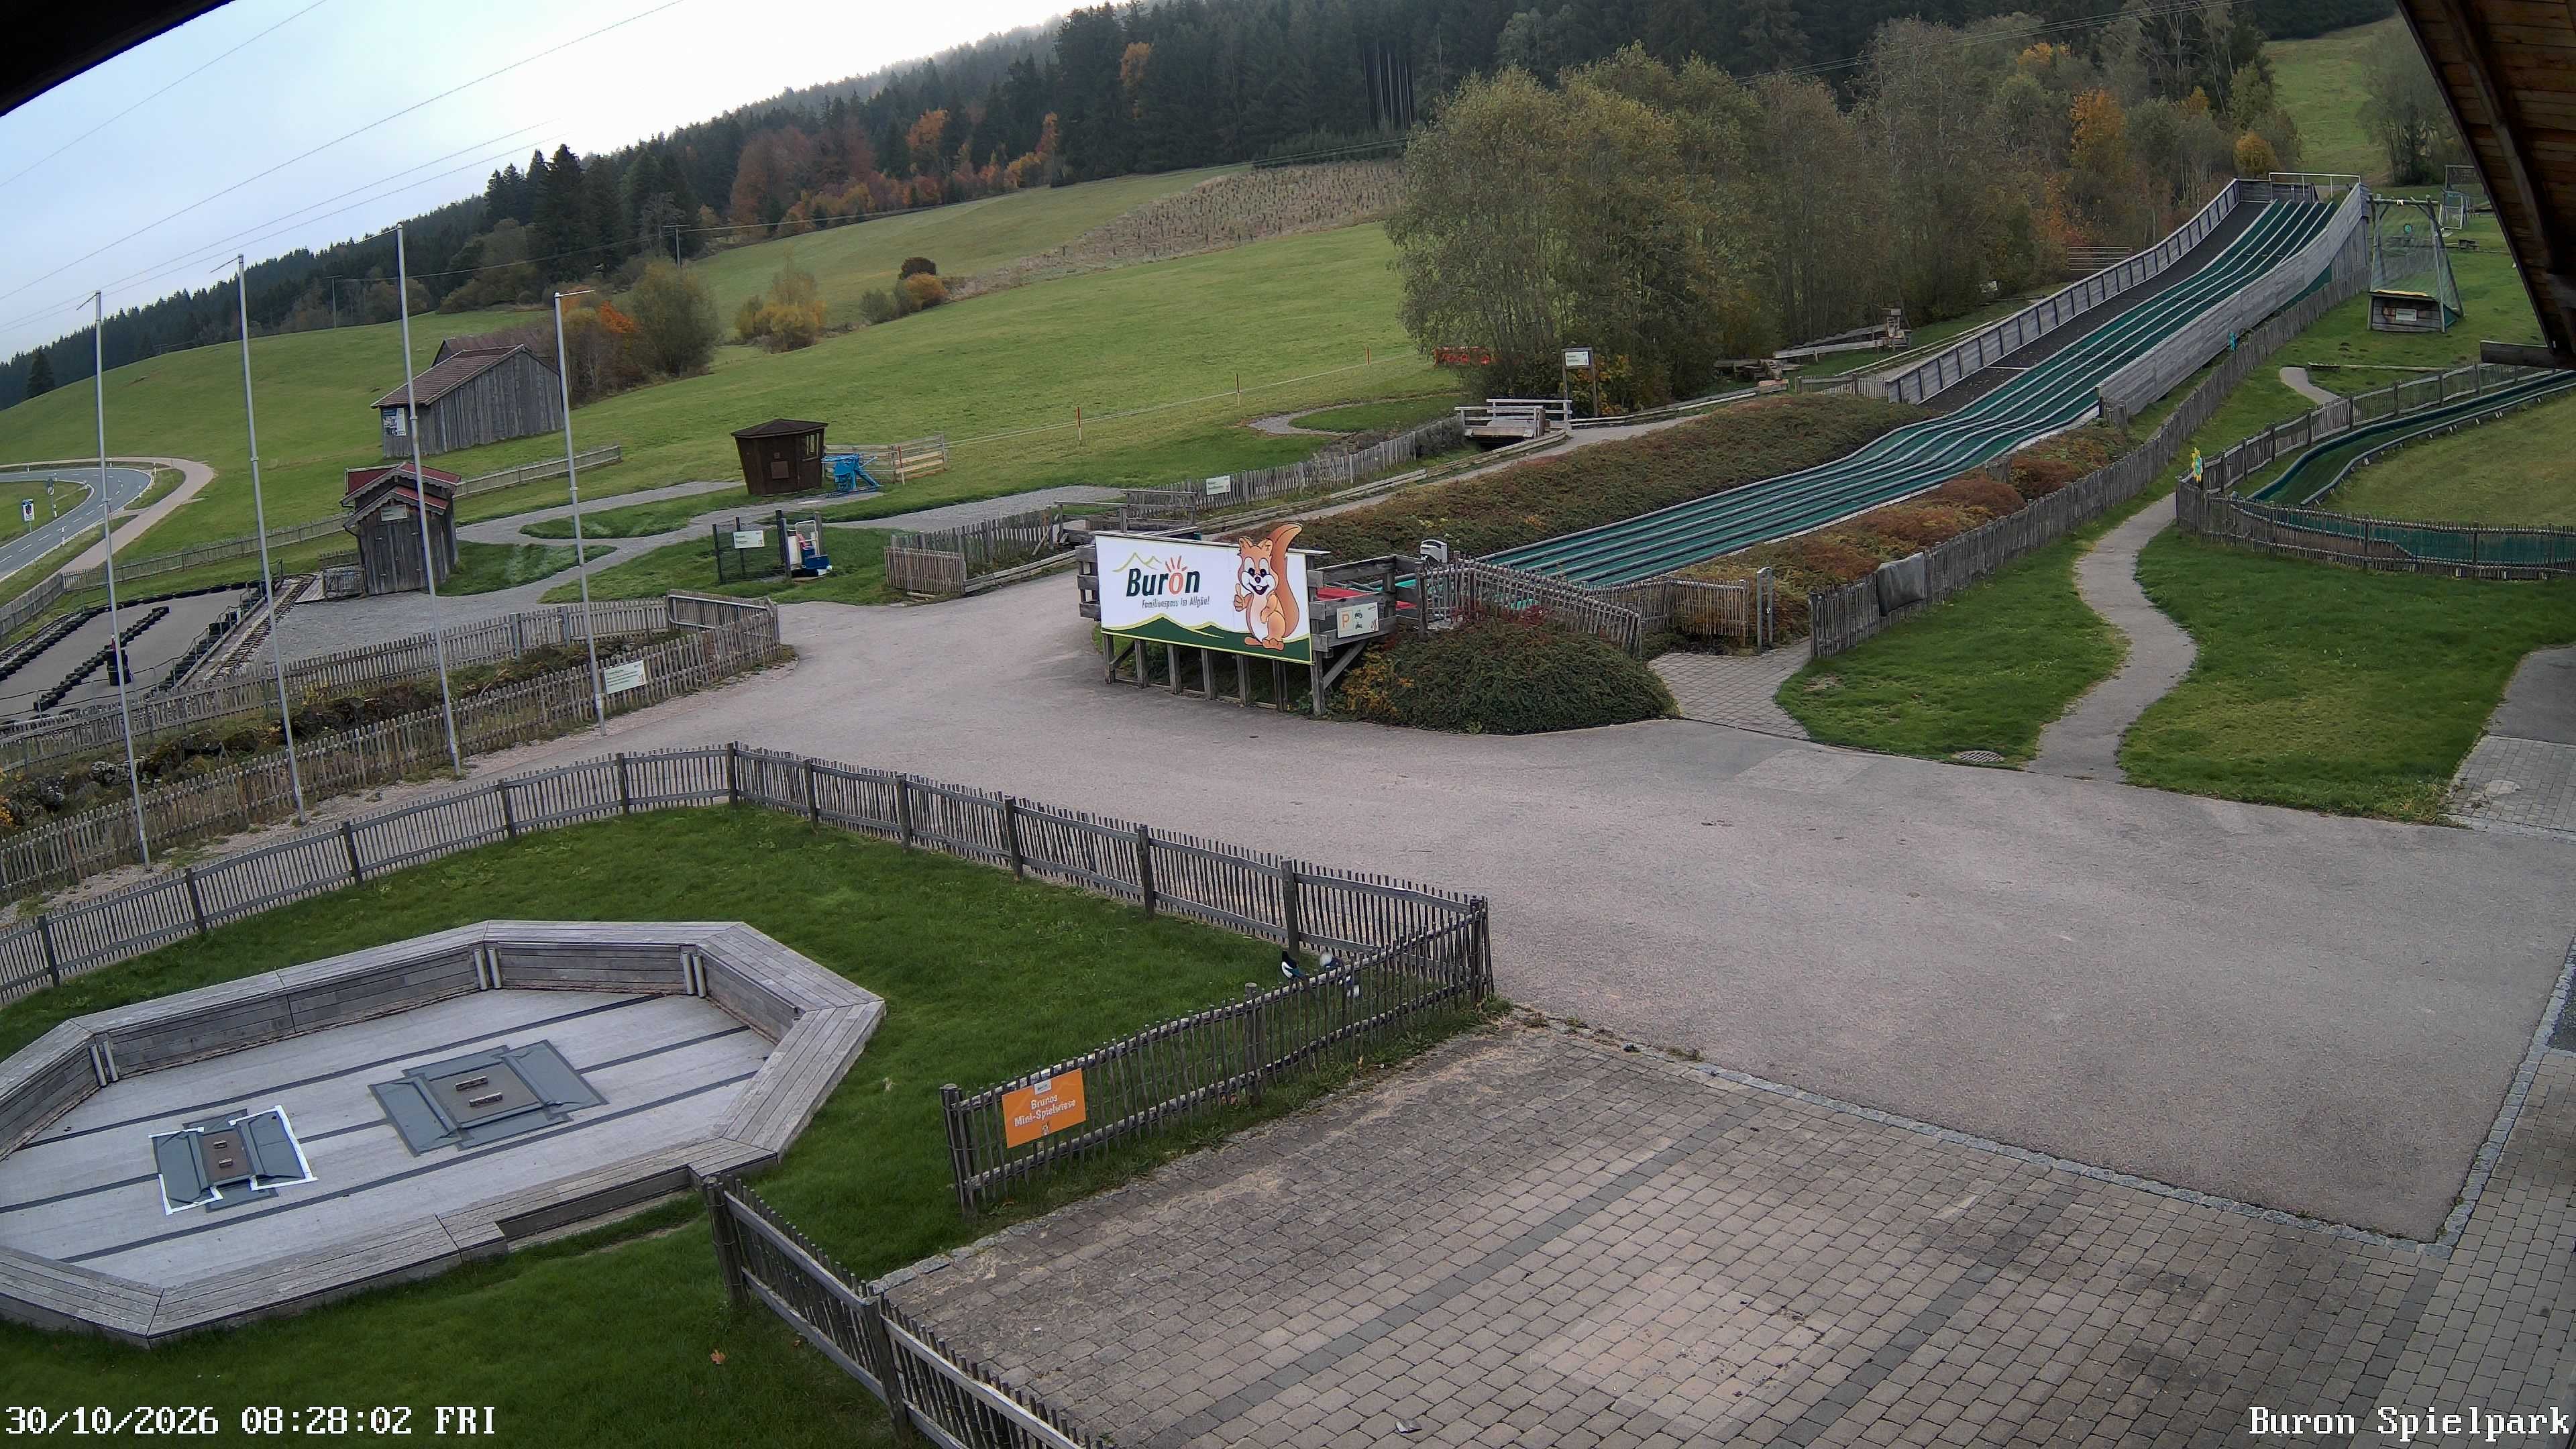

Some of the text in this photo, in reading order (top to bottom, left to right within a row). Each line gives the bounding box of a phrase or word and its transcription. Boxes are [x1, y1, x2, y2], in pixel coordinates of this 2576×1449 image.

[1126, 568, 1201, 596] Buron
[1014, 1100, 1076, 1127] Mini-Spielwiese
[1030, 1094, 1059, 1110] Brunos
